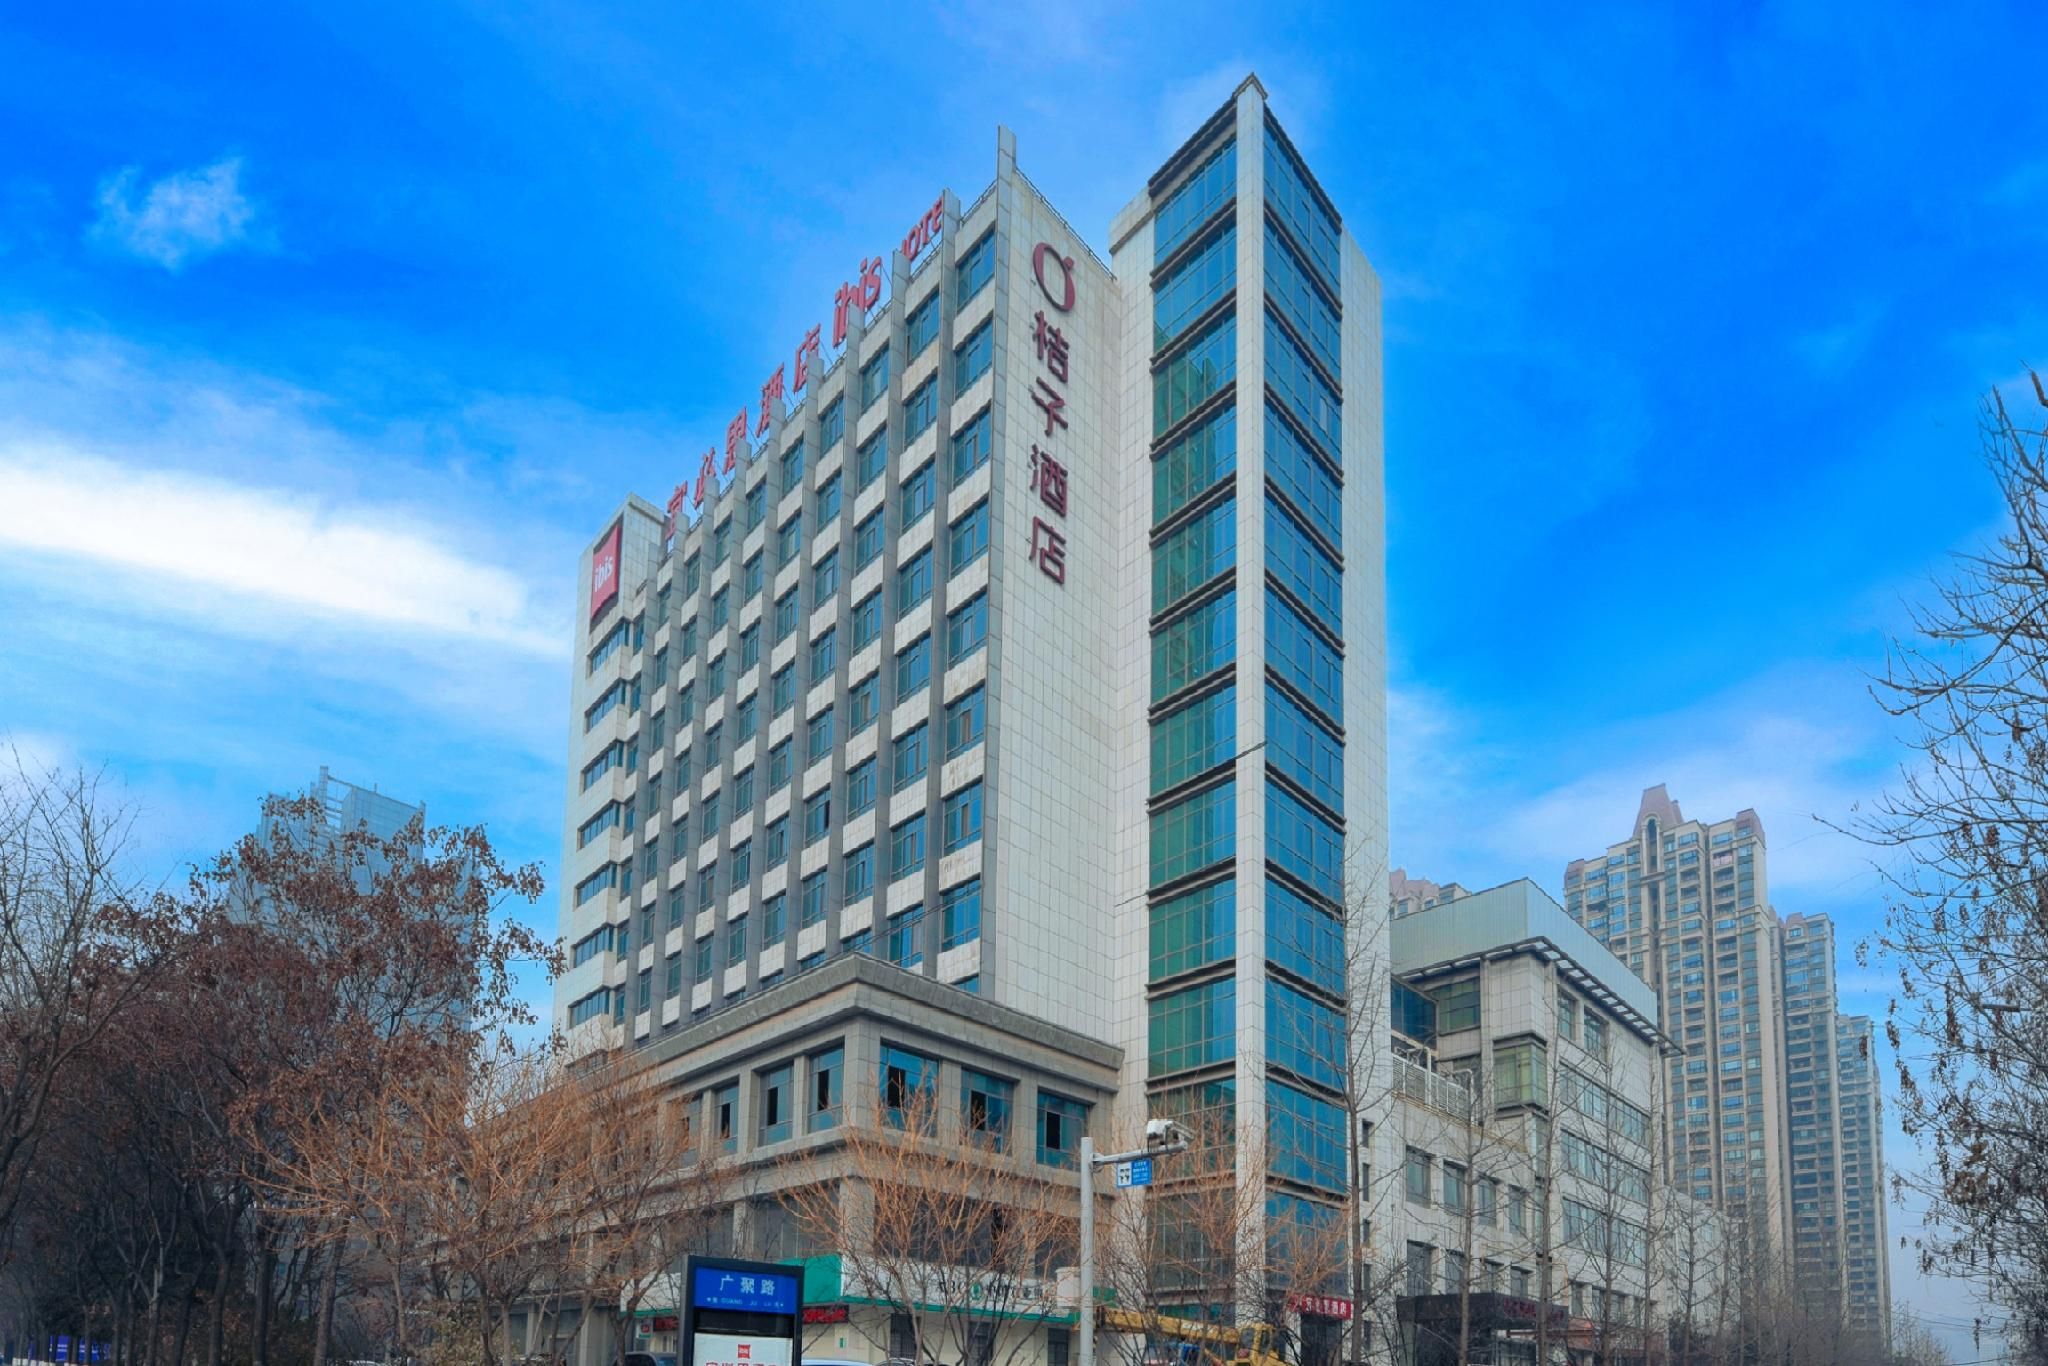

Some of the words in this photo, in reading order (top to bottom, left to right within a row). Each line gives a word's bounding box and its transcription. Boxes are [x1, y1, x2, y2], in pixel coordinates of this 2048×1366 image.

[832, 256, 882, 349] ibis
[1028, 309, 1069, 586] 桔子酒店
[594, 555, 614, 593] ibis
[719, 1274, 776, 1297] 广聚路
